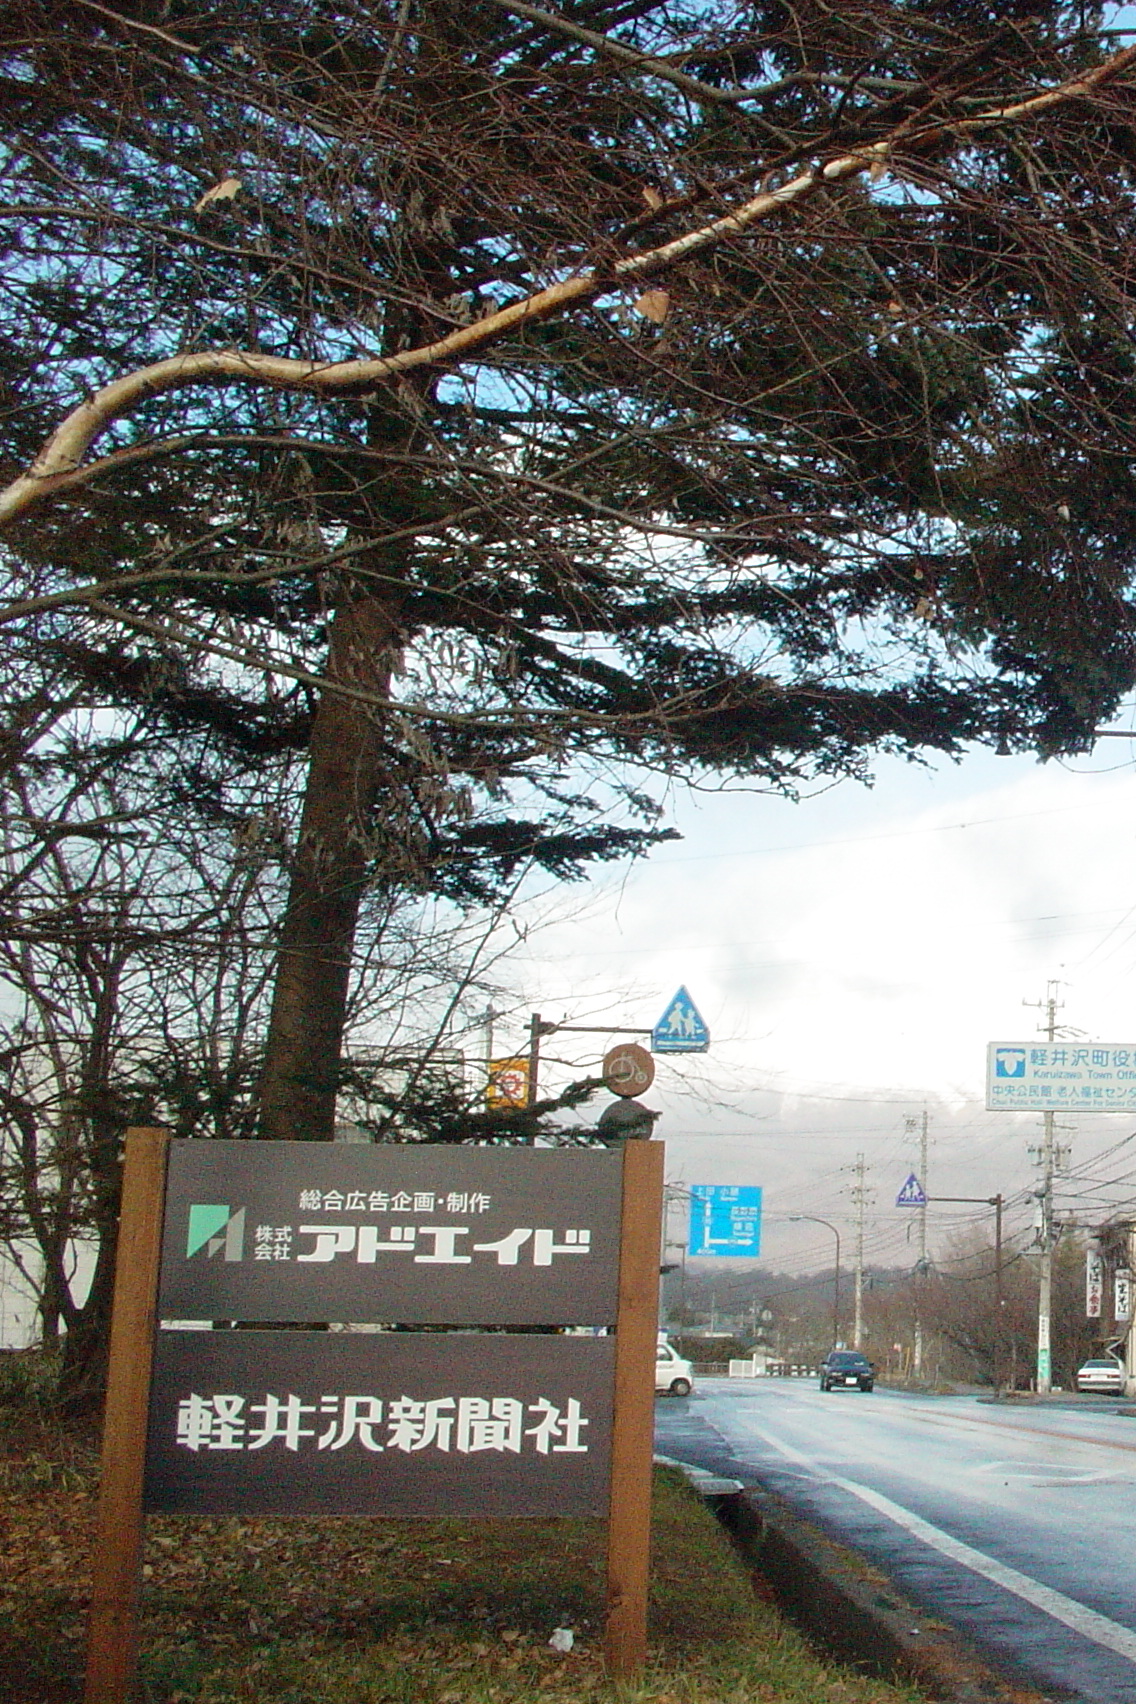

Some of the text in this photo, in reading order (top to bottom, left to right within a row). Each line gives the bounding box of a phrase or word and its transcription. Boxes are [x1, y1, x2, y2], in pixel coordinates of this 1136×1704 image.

[1033, 1069, 1082, 1079] Karuizawa
[1087, 1069, 1112, 1079] Town
[992, 1084, 1051, 1097] 中央公民館
[299, 1190, 491, 1213] 総合広告企画・制作
[297, 1225, 591, 1266] アドエイド
[1118, 1282, 1128, 1314] 生そば
[175, 1392, 589, 1455] 軽井沢新聞社
